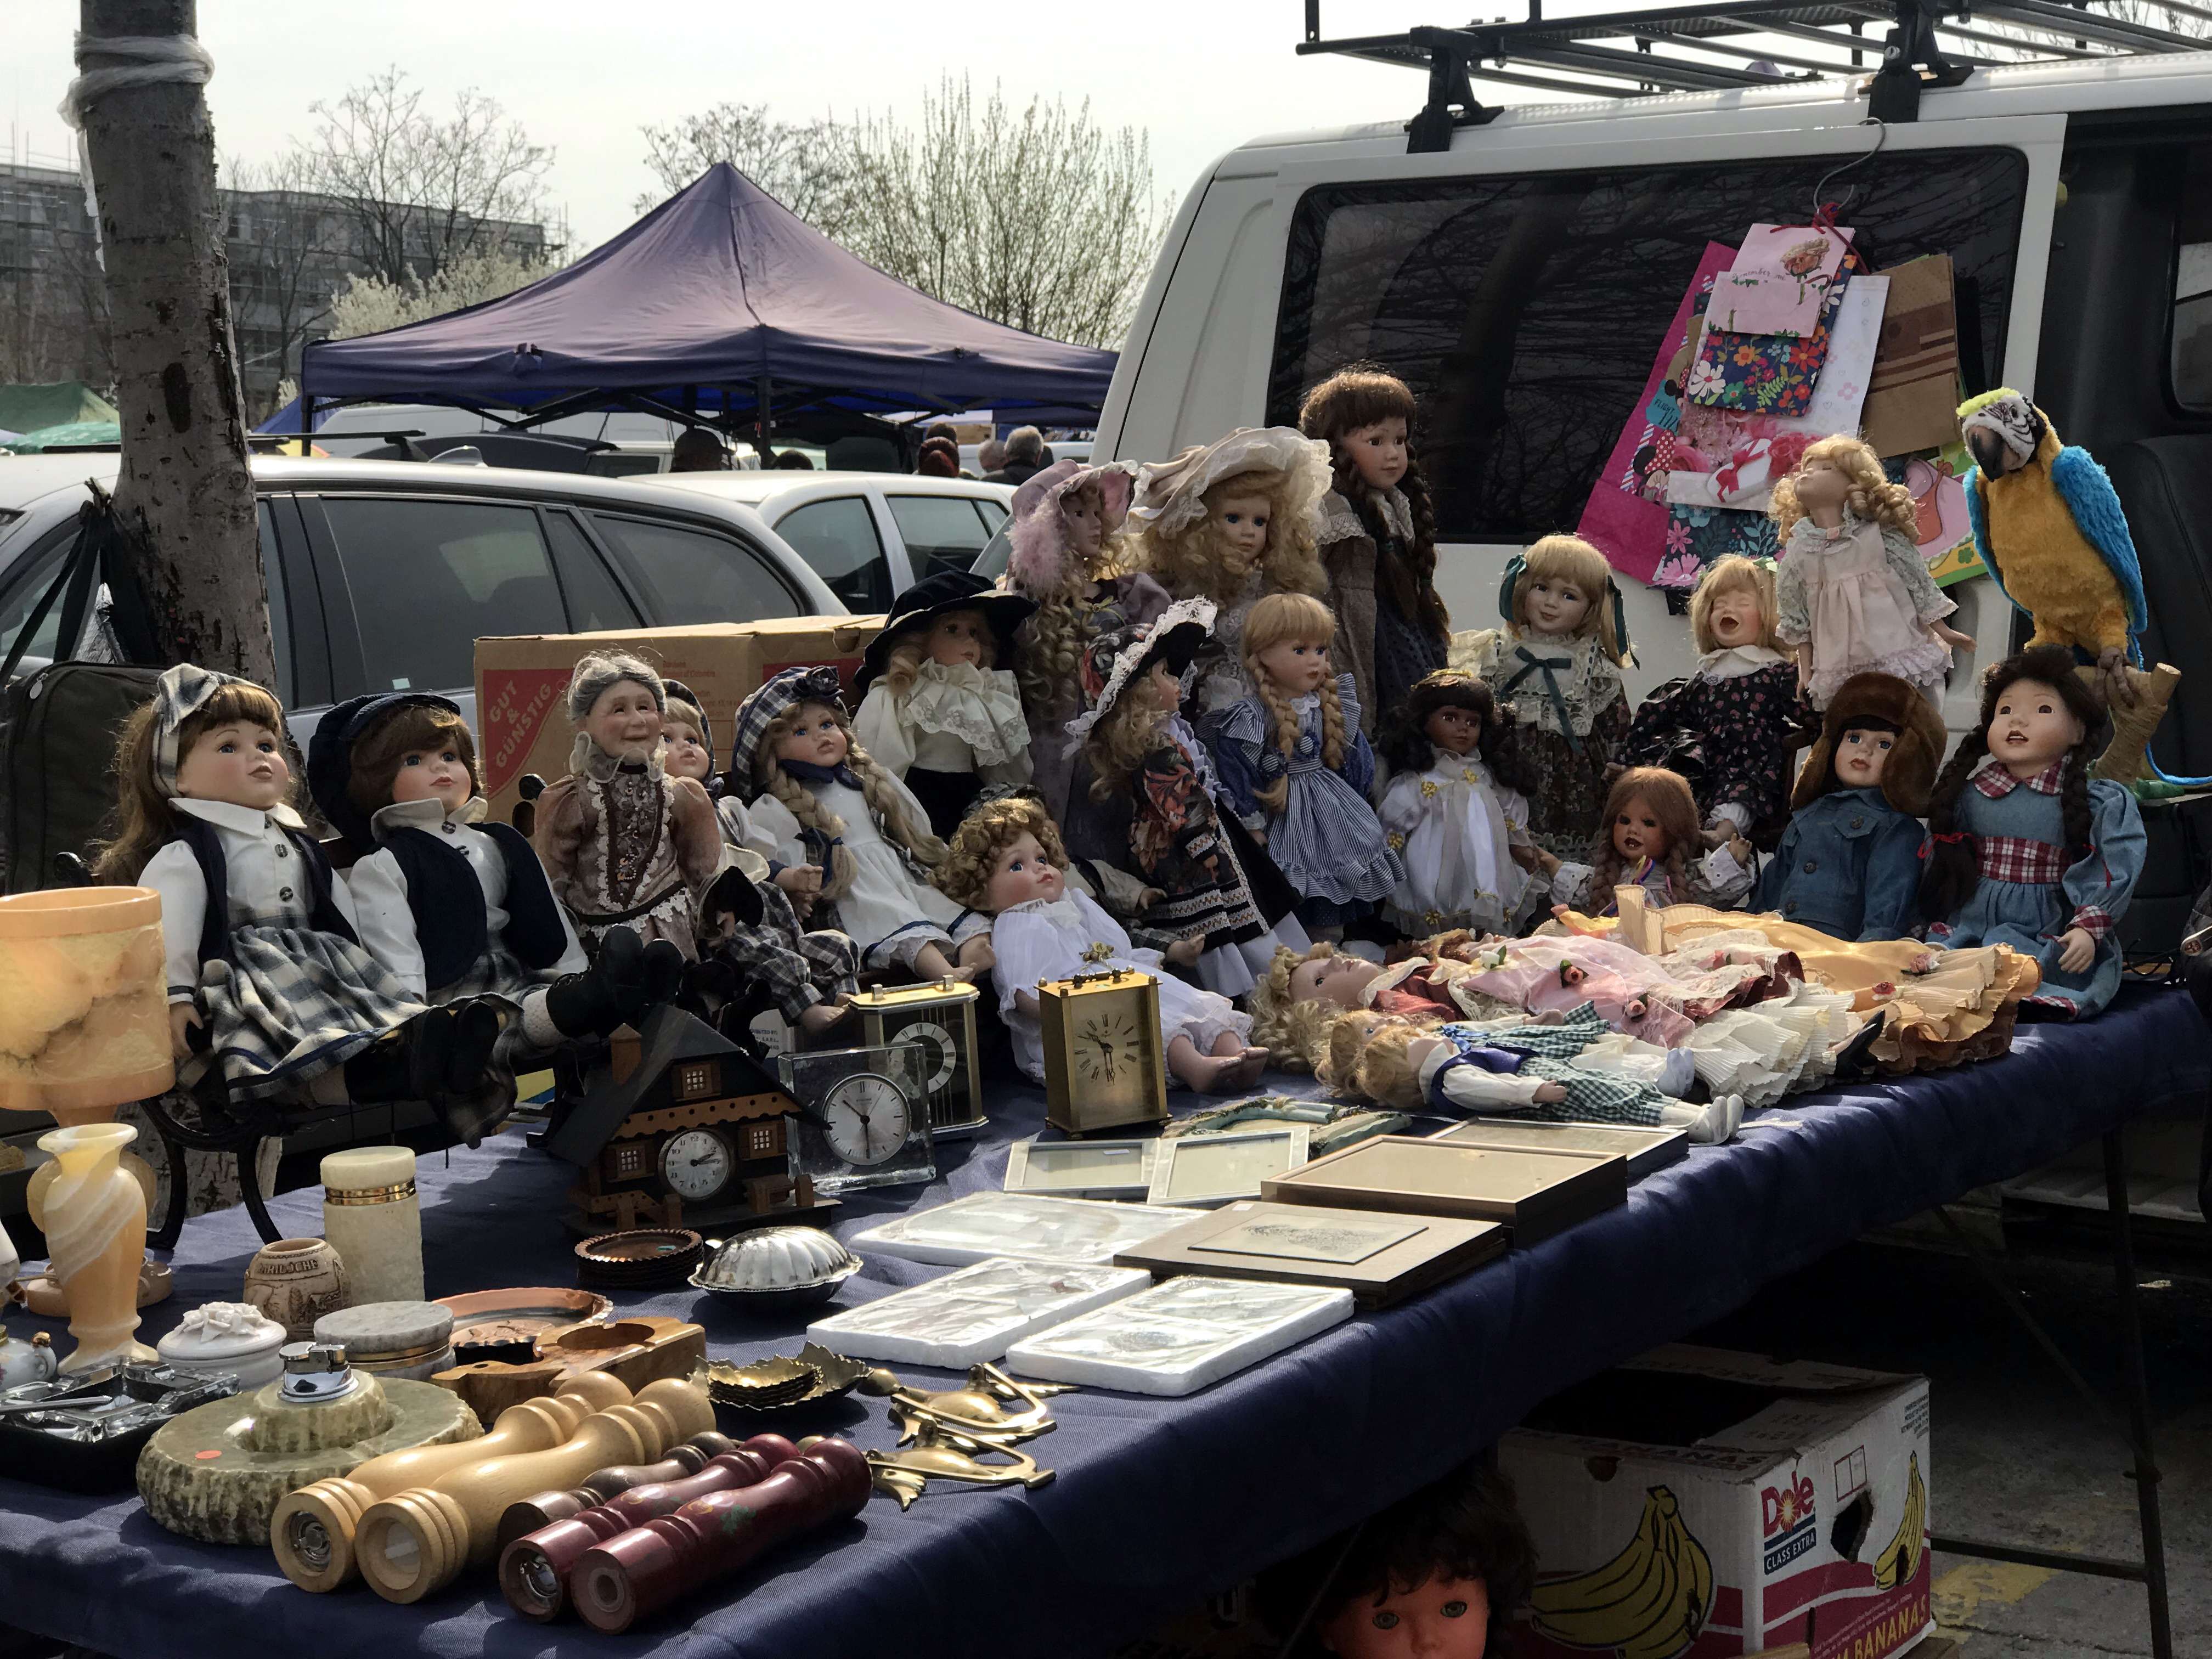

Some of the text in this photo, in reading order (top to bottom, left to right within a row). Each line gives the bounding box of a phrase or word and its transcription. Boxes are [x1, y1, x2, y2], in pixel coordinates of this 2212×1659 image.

[489, 680, 517, 723] GUT
[496, 684, 551, 768] GÜNSTIG
[507, 708, 520, 724] &
[1761, 1471, 1814, 1538] Dole
[1767, 1532, 1815, 1570] CLASS EXTRA
[1855, 1594, 1926, 1659] BANANAS
